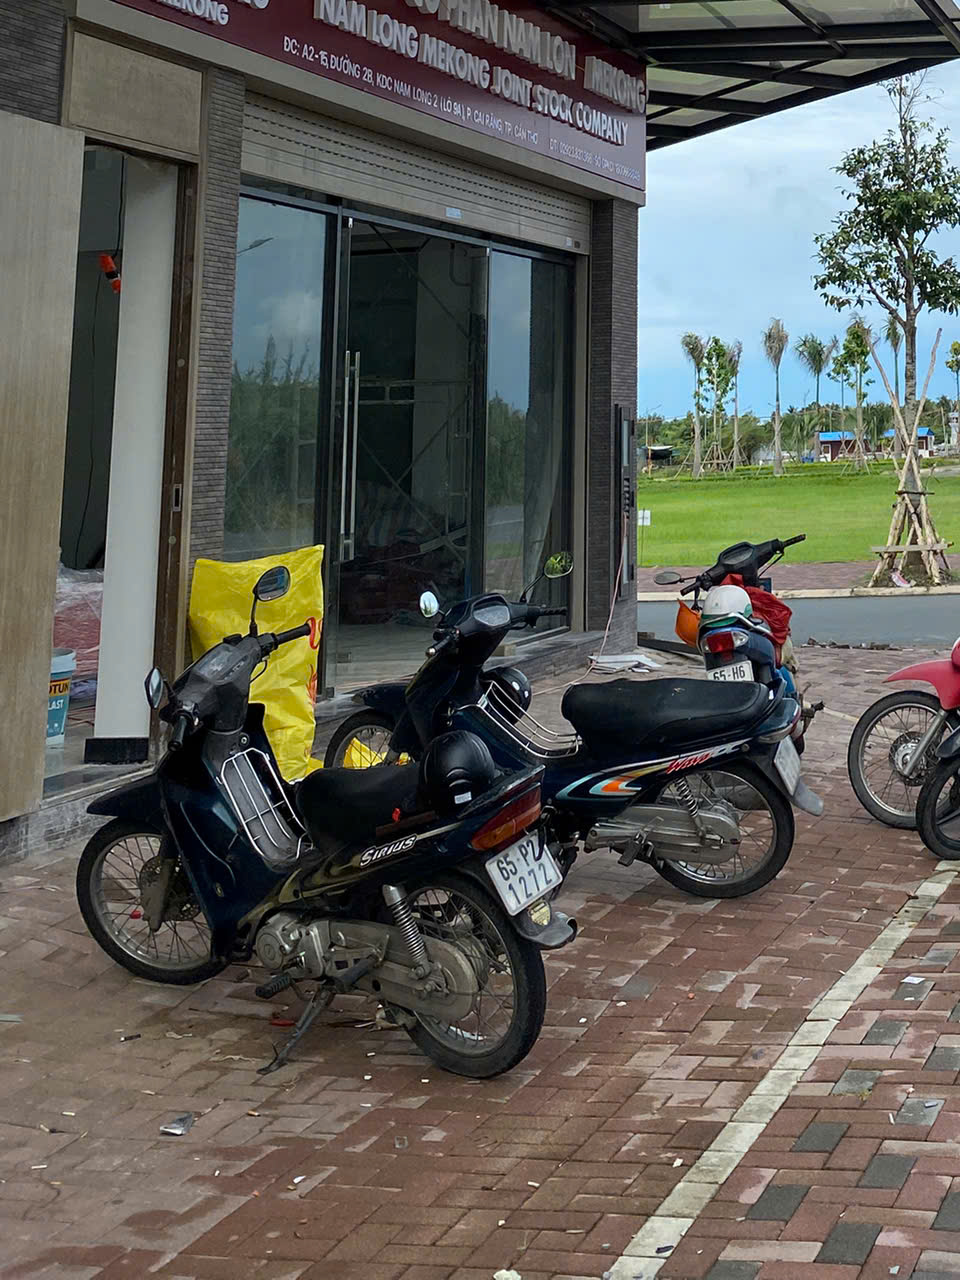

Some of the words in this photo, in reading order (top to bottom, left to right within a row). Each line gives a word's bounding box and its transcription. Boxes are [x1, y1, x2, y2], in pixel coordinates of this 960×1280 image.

[283, 36, 300, 56] ĐC:
[330, 53, 361, 79] ĐƯỜNG
[376, 73, 393, 91] KDC
[393, 81, 412, 98] NAM
[412, 87, 432, 107] LONG
[432, 96, 438, 108] 2
[366, 9, 419, 58] LONG
[417, 33, 491, 89] MEKONG
[490, 66, 533, 108] JOINT
[532, 84, 574, 125] STOCK
[572, 101, 629, 147] COMPANY
[498, 9, 541, 65] NAM
[584, 55, 647, 114] MEKONG
[507, 861, 553, 906] 1272
